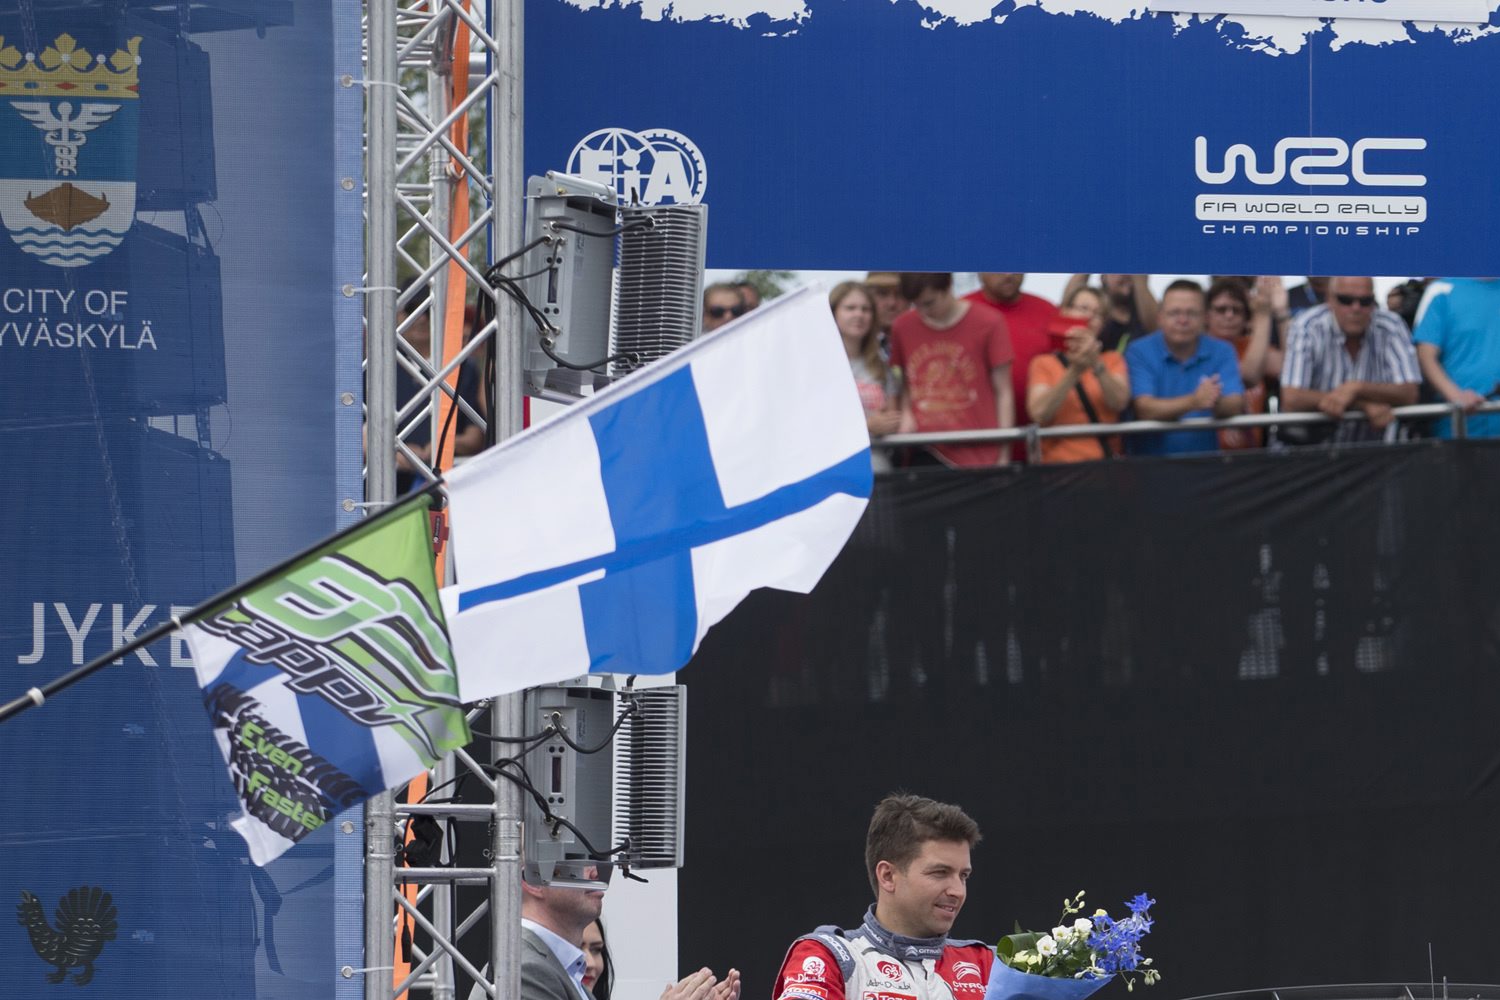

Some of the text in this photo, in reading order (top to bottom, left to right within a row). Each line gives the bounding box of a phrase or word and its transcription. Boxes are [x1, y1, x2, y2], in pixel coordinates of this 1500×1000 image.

[1195, 135, 1427, 187] WRC
[1203, 202, 1420, 215] FIA WORLD RALLY
[1202, 224, 1420, 236] CHAMPIONSHIP
[3, 288, 128, 315] CITY OF
[240, 720, 303, 775] Even
